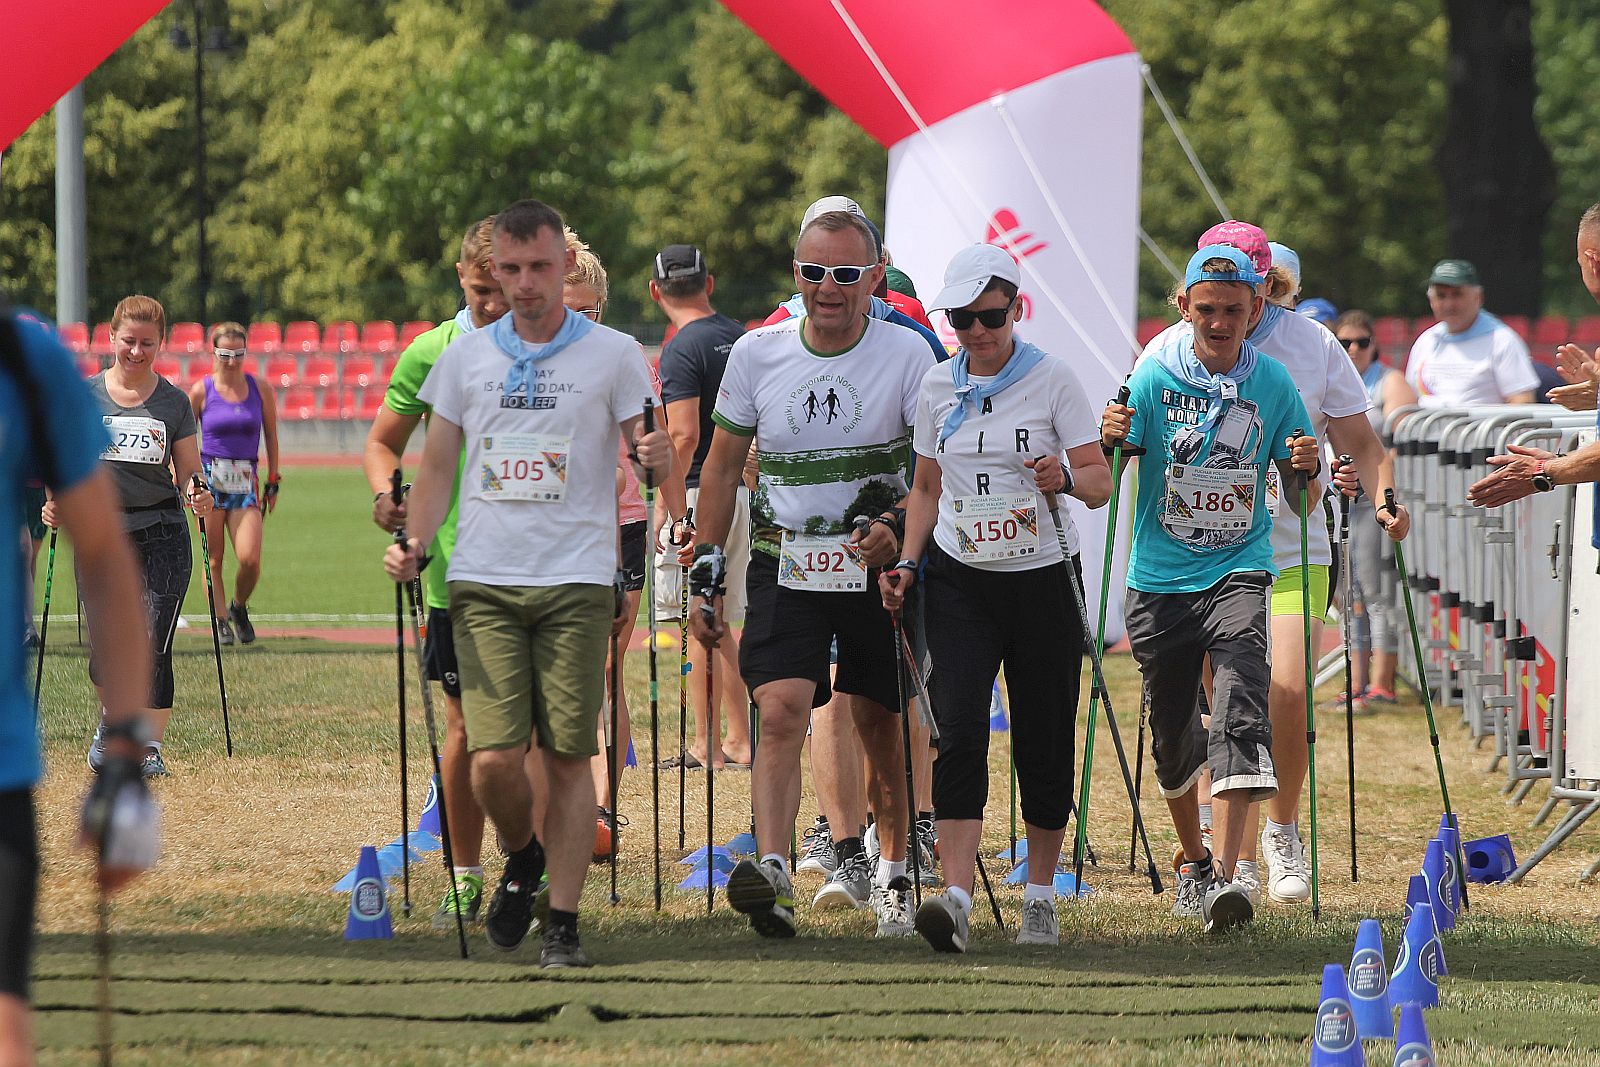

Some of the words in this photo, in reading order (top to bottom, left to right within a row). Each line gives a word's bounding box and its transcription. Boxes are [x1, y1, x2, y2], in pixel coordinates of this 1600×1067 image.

[484, 381, 494, 392] IS
[790, 373, 834, 399] Pasjonaci
[835, 375, 859, 400] Nordic
[502, 396, 518, 408] TO
[520, 397, 556, 409] SEEP
[1162, 389, 1208, 412] RELAX
[842, 400, 863, 434] Walking
[1167, 407, 1198, 425] NOW
[118, 432, 150, 449] 275
[977, 431, 984, 453] I
[1015, 428, 1030, 453] R
[500, 459, 544, 481] 105
[976, 473, 990, 495] R
[1191, 490, 1235, 513] 186
[973, 519, 1018, 543] 150
[803, 551, 845, 573] 192
